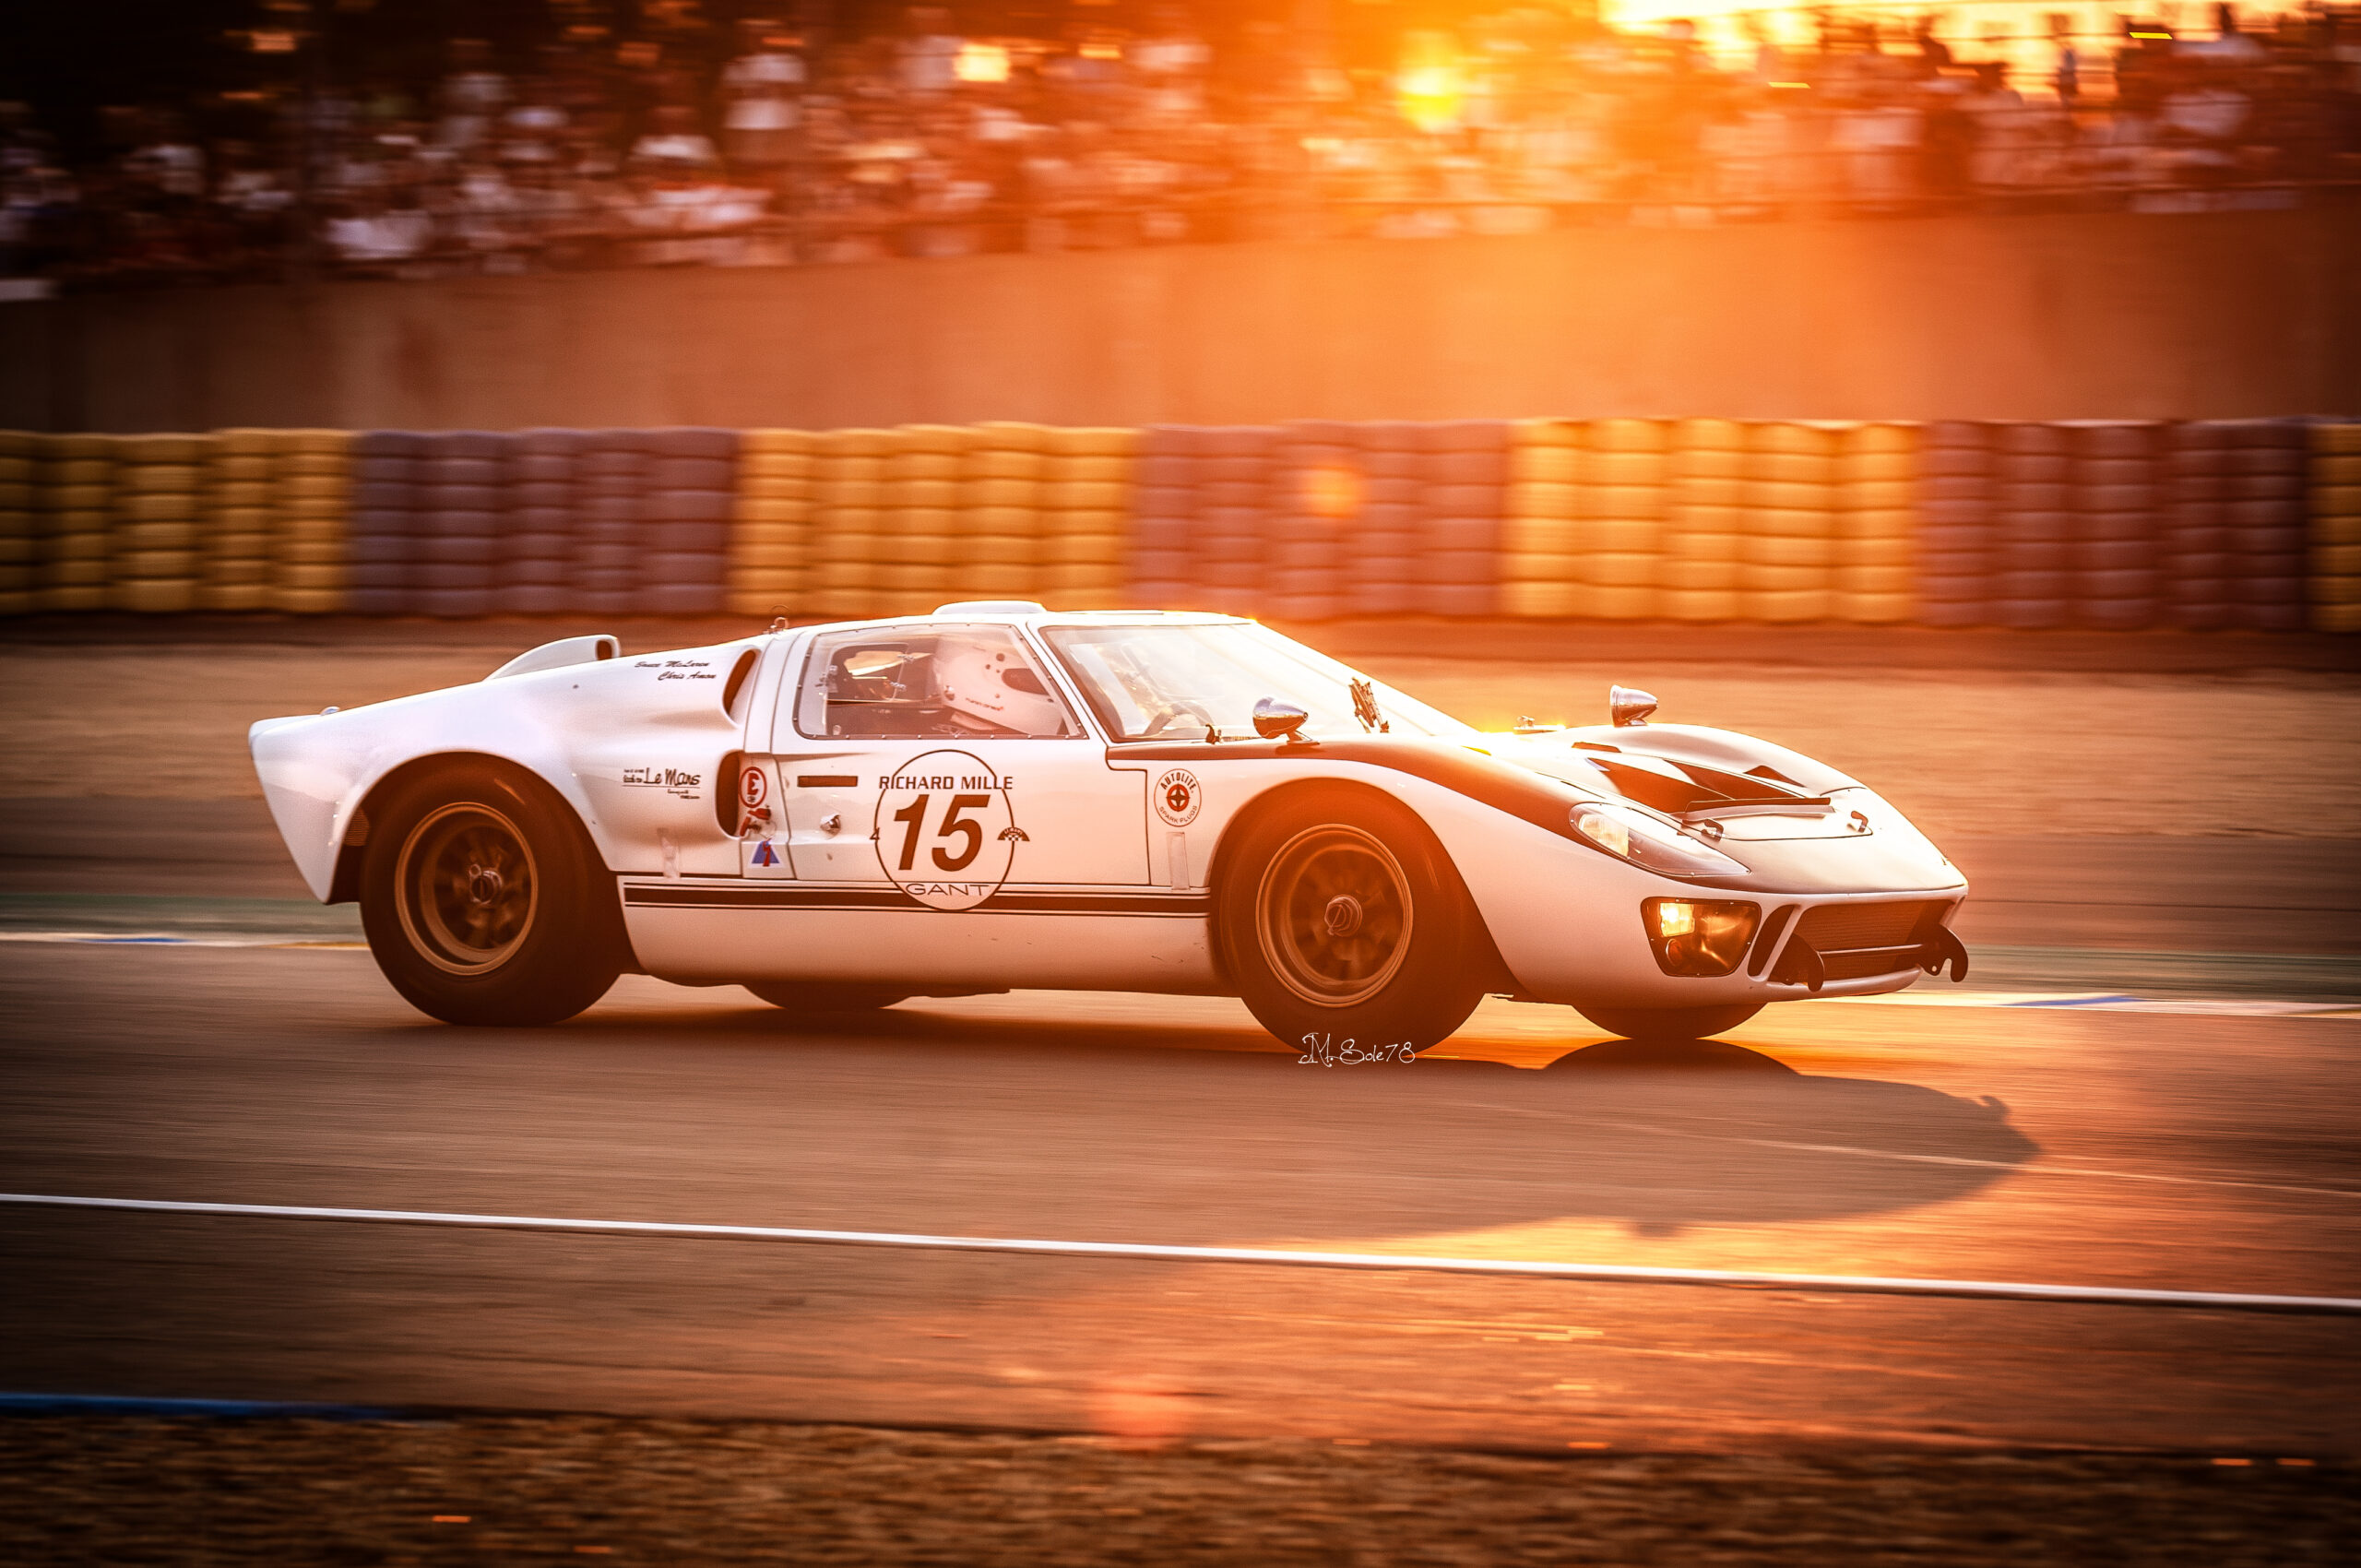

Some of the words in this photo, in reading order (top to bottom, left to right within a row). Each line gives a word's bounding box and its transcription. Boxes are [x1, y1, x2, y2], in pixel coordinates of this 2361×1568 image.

[658, 671, 684, 681] Chris
[643, 767, 662, 784] Le
[665, 768, 701, 787] Mans
[879, 776, 954, 790] RICHARD
[961, 776, 1013, 790] MILLE
[1160, 772, 1196, 790] AUTOLITE
[893, 794, 991, 872] 15
[906, 883, 990, 897] GANT
